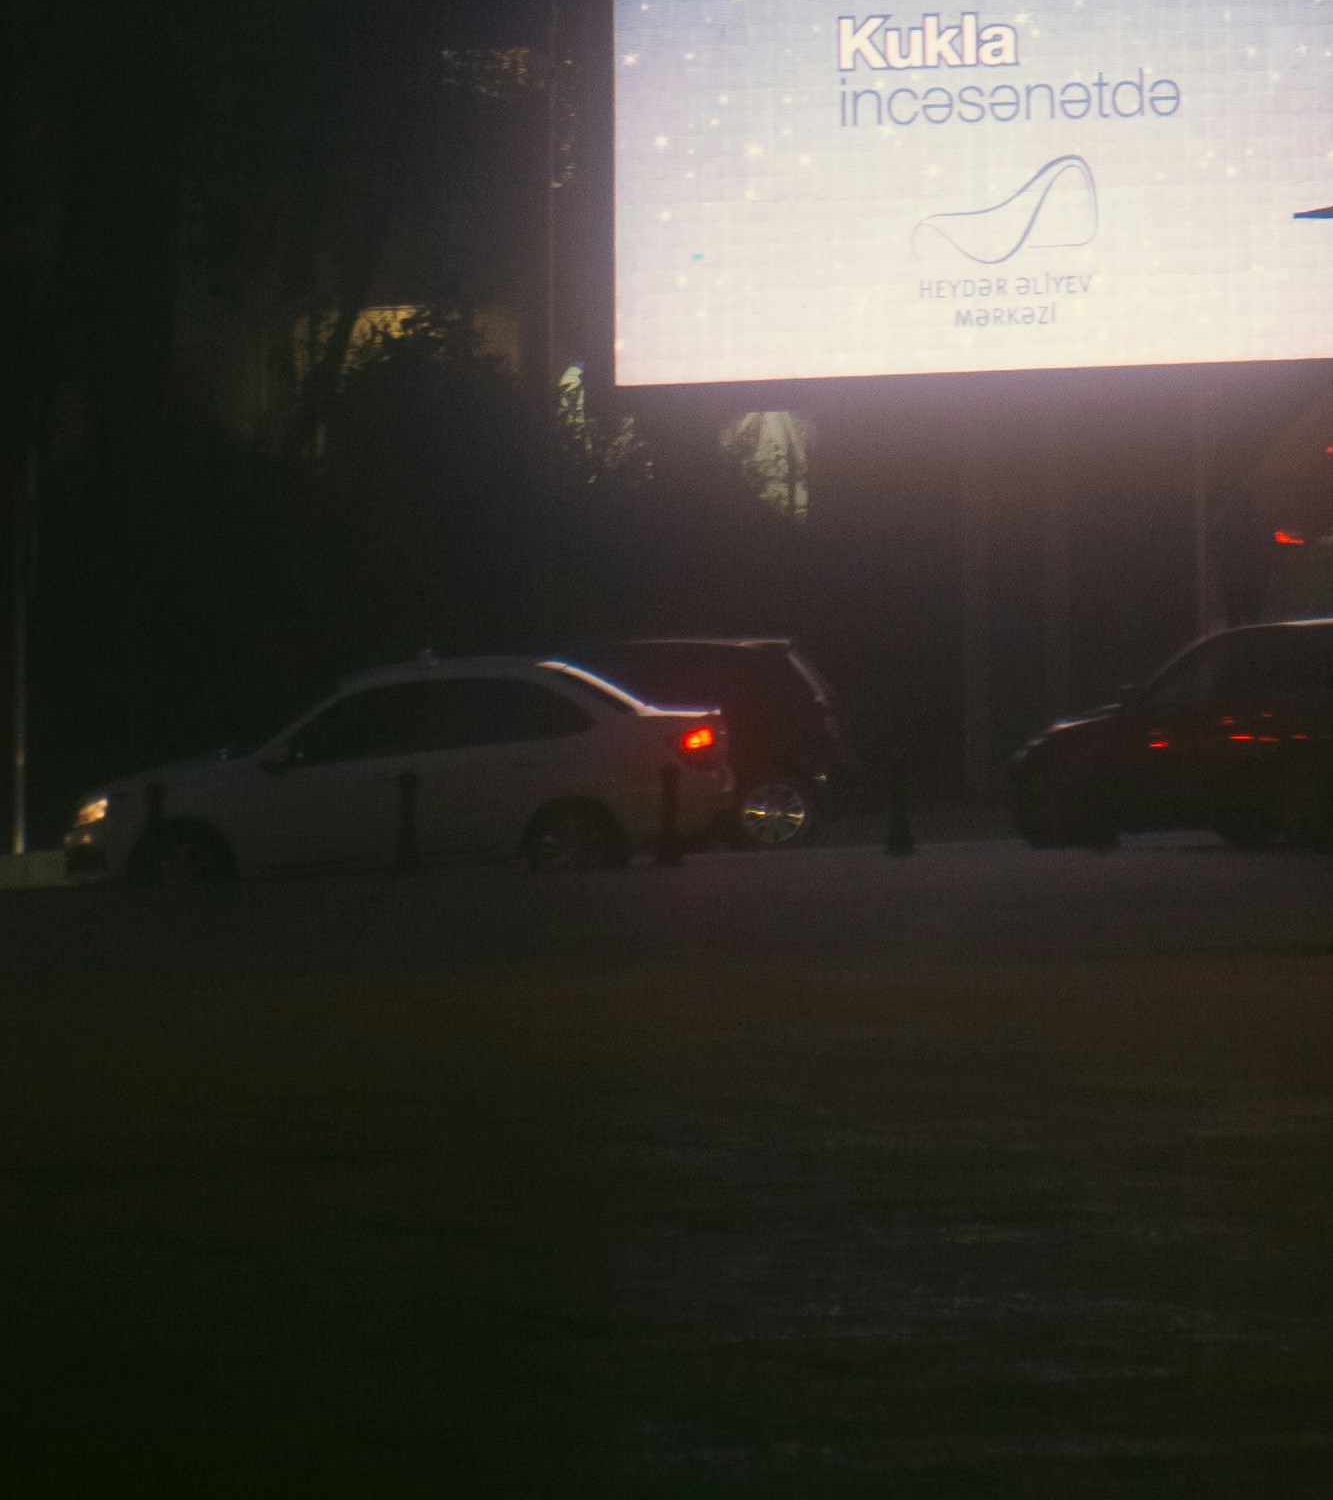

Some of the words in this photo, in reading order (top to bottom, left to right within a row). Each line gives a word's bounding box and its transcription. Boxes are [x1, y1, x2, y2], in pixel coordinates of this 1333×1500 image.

[837, 13, 1018, 70] Kukla
[838, 68, 1181, 128] incəsənətdə
[918, 276, 1007, 299] HEYDƏR
[1015, 272, 1093, 295] ƏLİYEV
[954, 301, 1058, 327] MƏRKƏZİ
